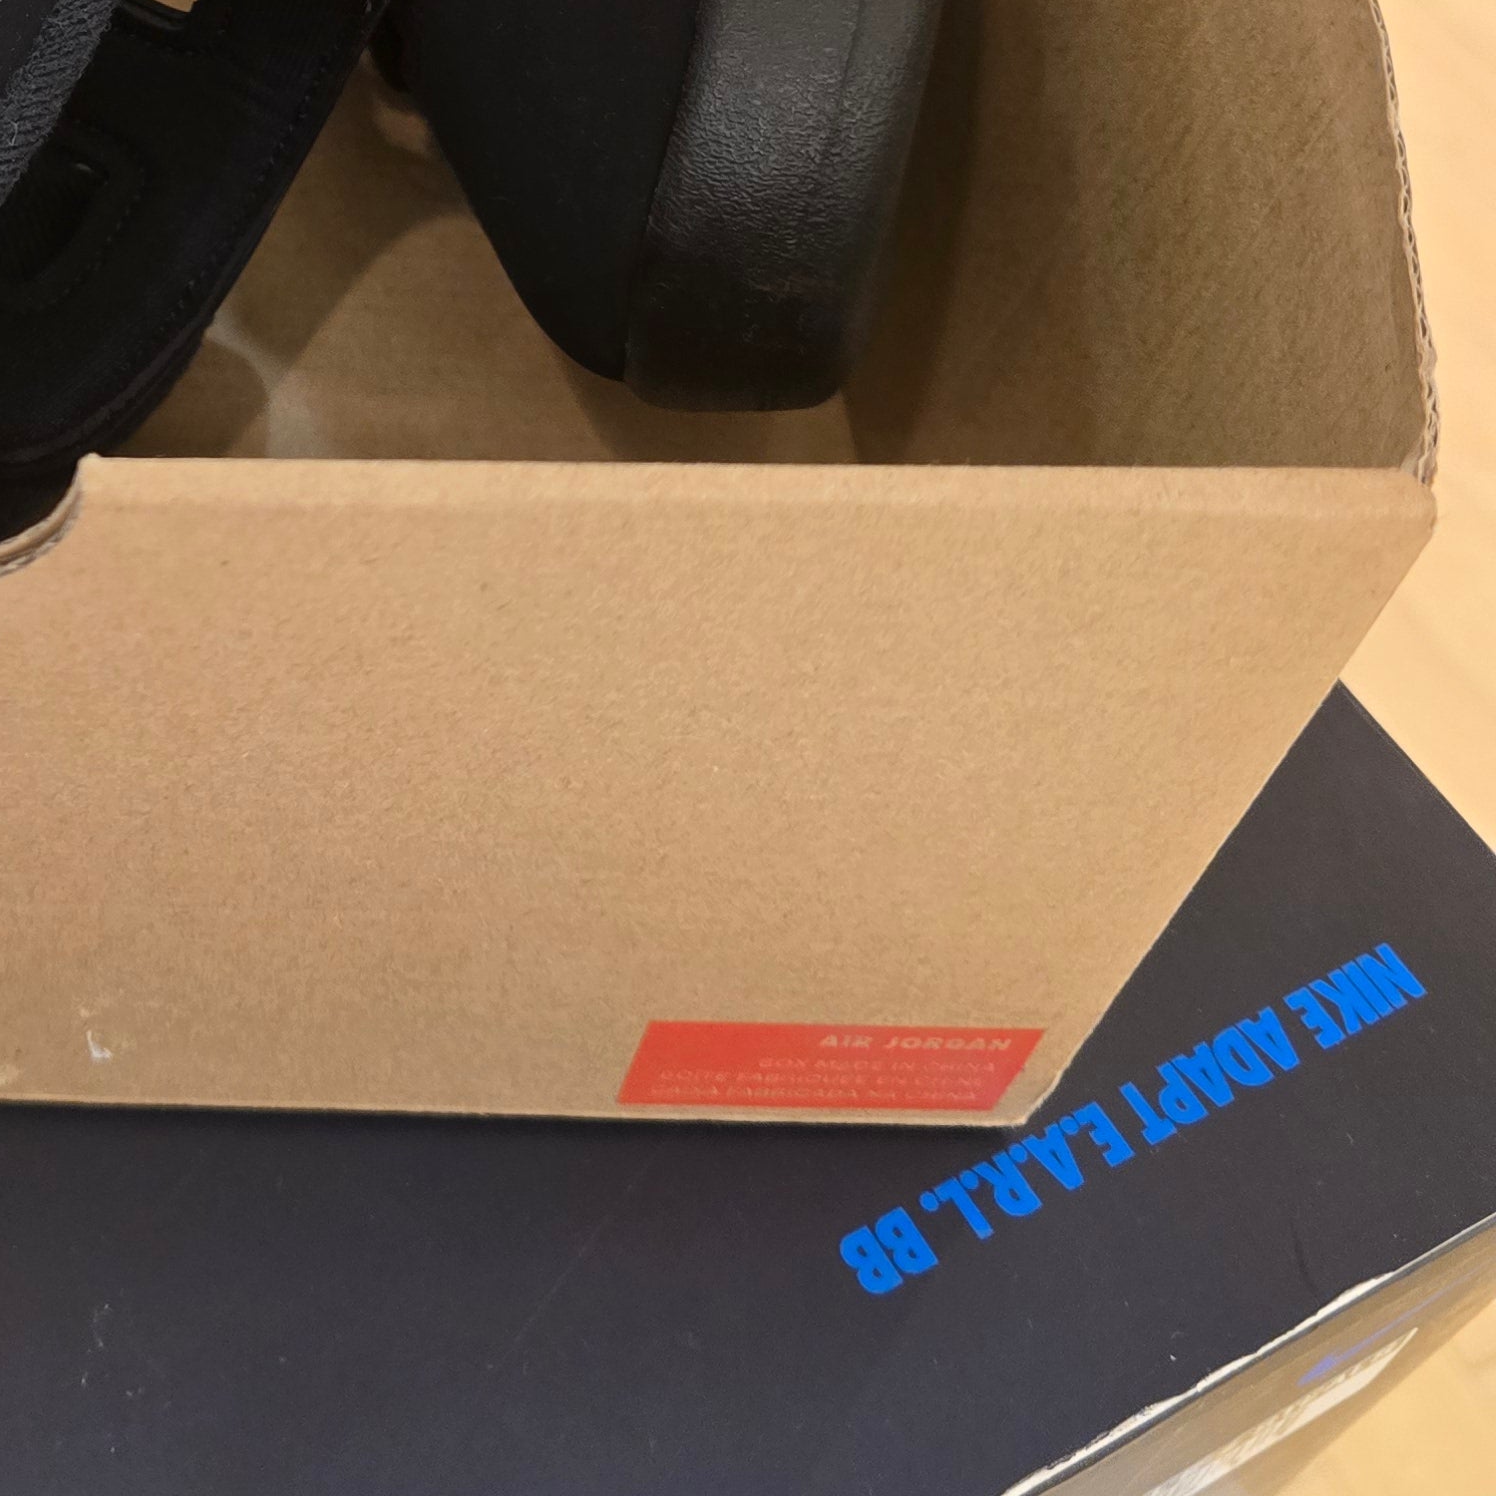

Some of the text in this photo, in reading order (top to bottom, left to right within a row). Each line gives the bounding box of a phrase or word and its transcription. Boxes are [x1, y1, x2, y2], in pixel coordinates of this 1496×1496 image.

[819, 1035, 1012, 1051] AIR JORDAN
[812, 1059, 881, 1071] MADE
[891, 1061, 916, 1071] IN
[839, 944, 1426, 1294] NIKE ADAPT E.A.R.L. BB
